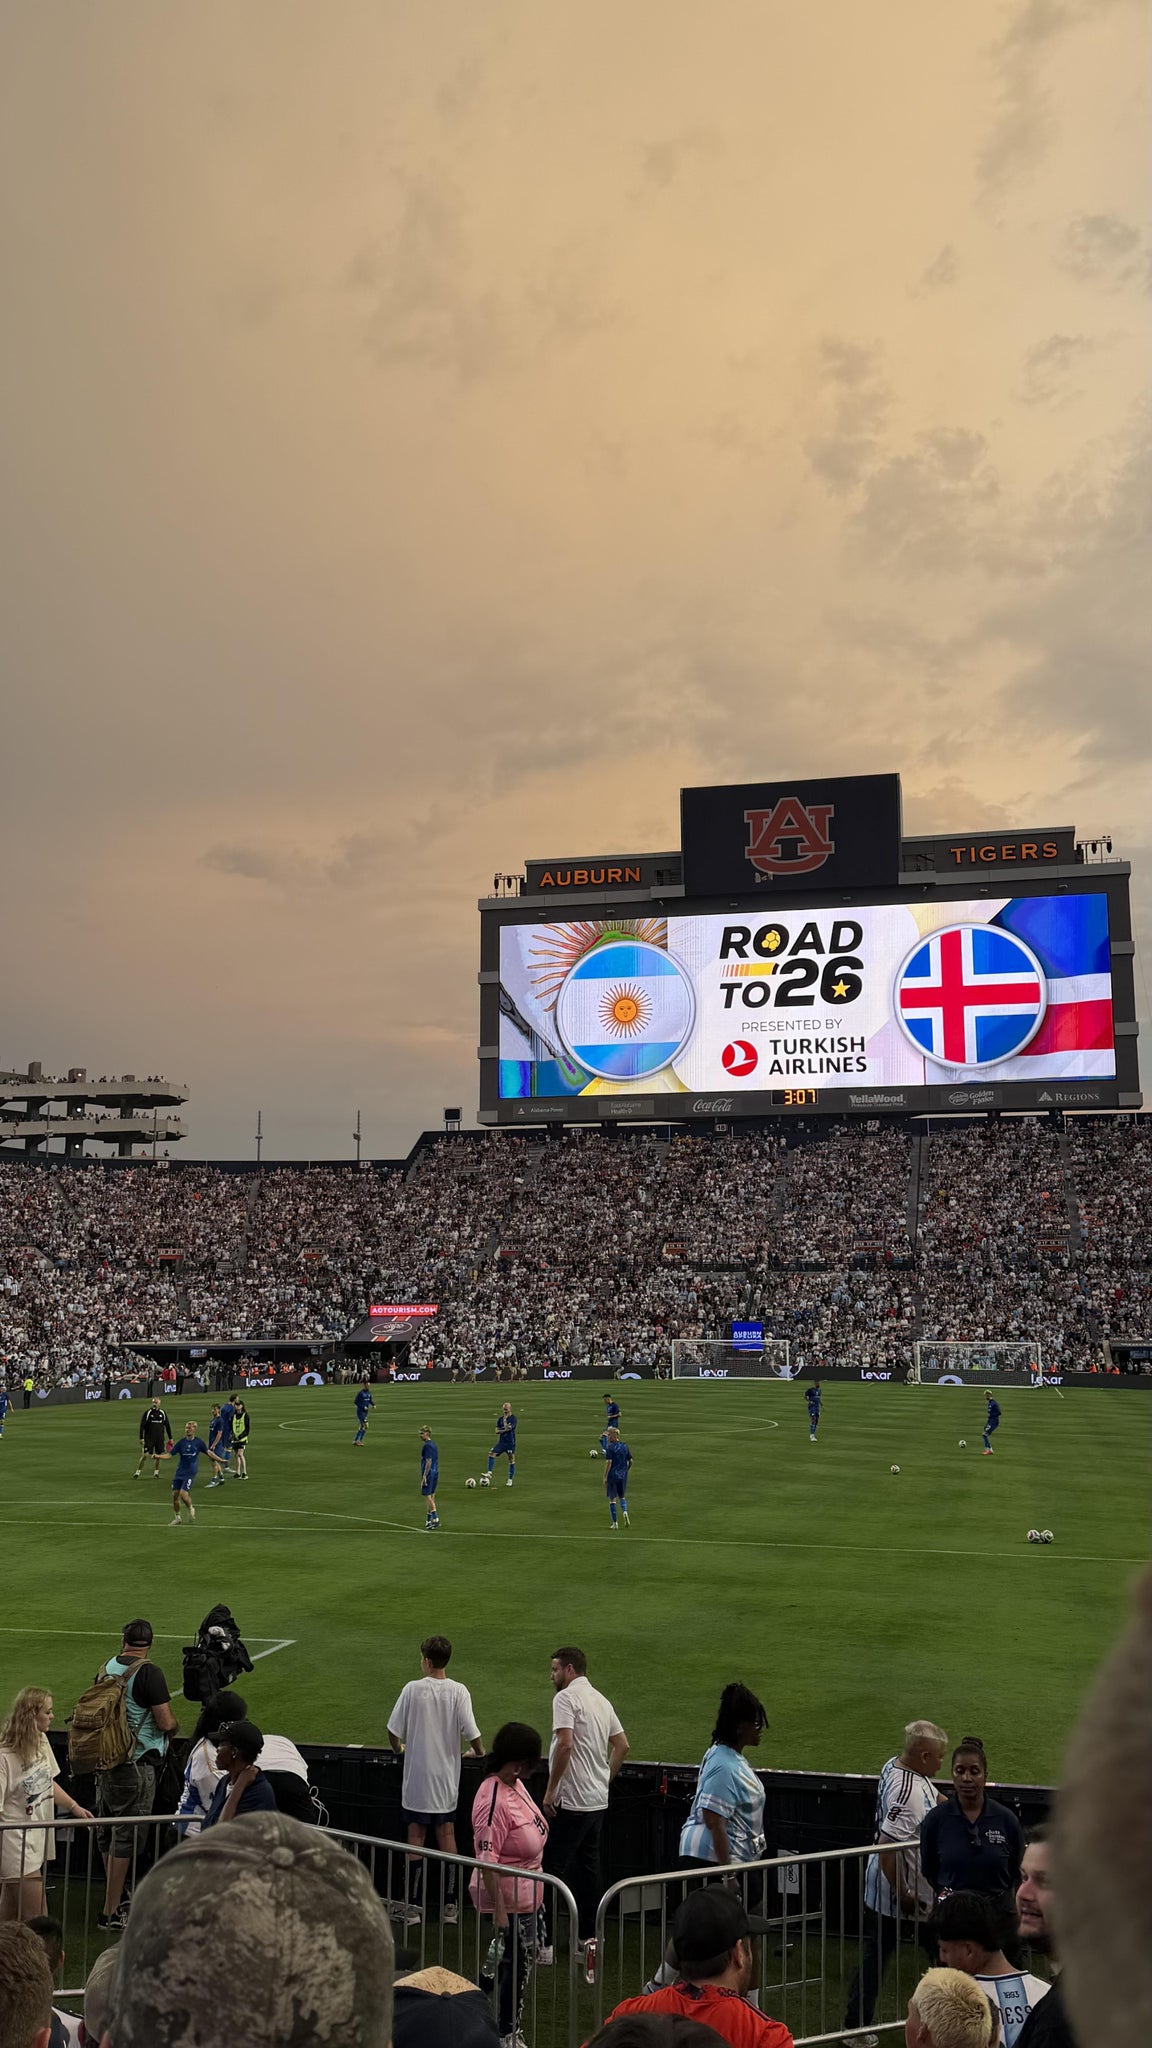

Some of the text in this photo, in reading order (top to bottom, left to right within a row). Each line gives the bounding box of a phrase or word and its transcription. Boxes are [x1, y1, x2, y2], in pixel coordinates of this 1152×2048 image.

[950, 842, 1058, 864] TIGERS
[540, 867, 641, 887] AUBURN
[719, 920, 863, 959] ROAD
[720, 981, 771, 1008] TO
[742, 1018, 843, 1033] PRESENTED BY
[769, 1036, 865, 1055] TURKISH
[769, 1056, 867, 1075] AIRLINES
[784, 1089, 816, 1105] 3:07
[969, 1090, 994, 1099] Golden
[393, 1370, 421, 1381] Lexar
[544, 1369, 572, 1378] Lexar
[699, 1367, 728, 1377] Lexar
[861, 1369, 892, 1380] Lexar
[1031, 1373, 1063, 1385] Lexar
[246, 1377, 274, 1387] Lexar
